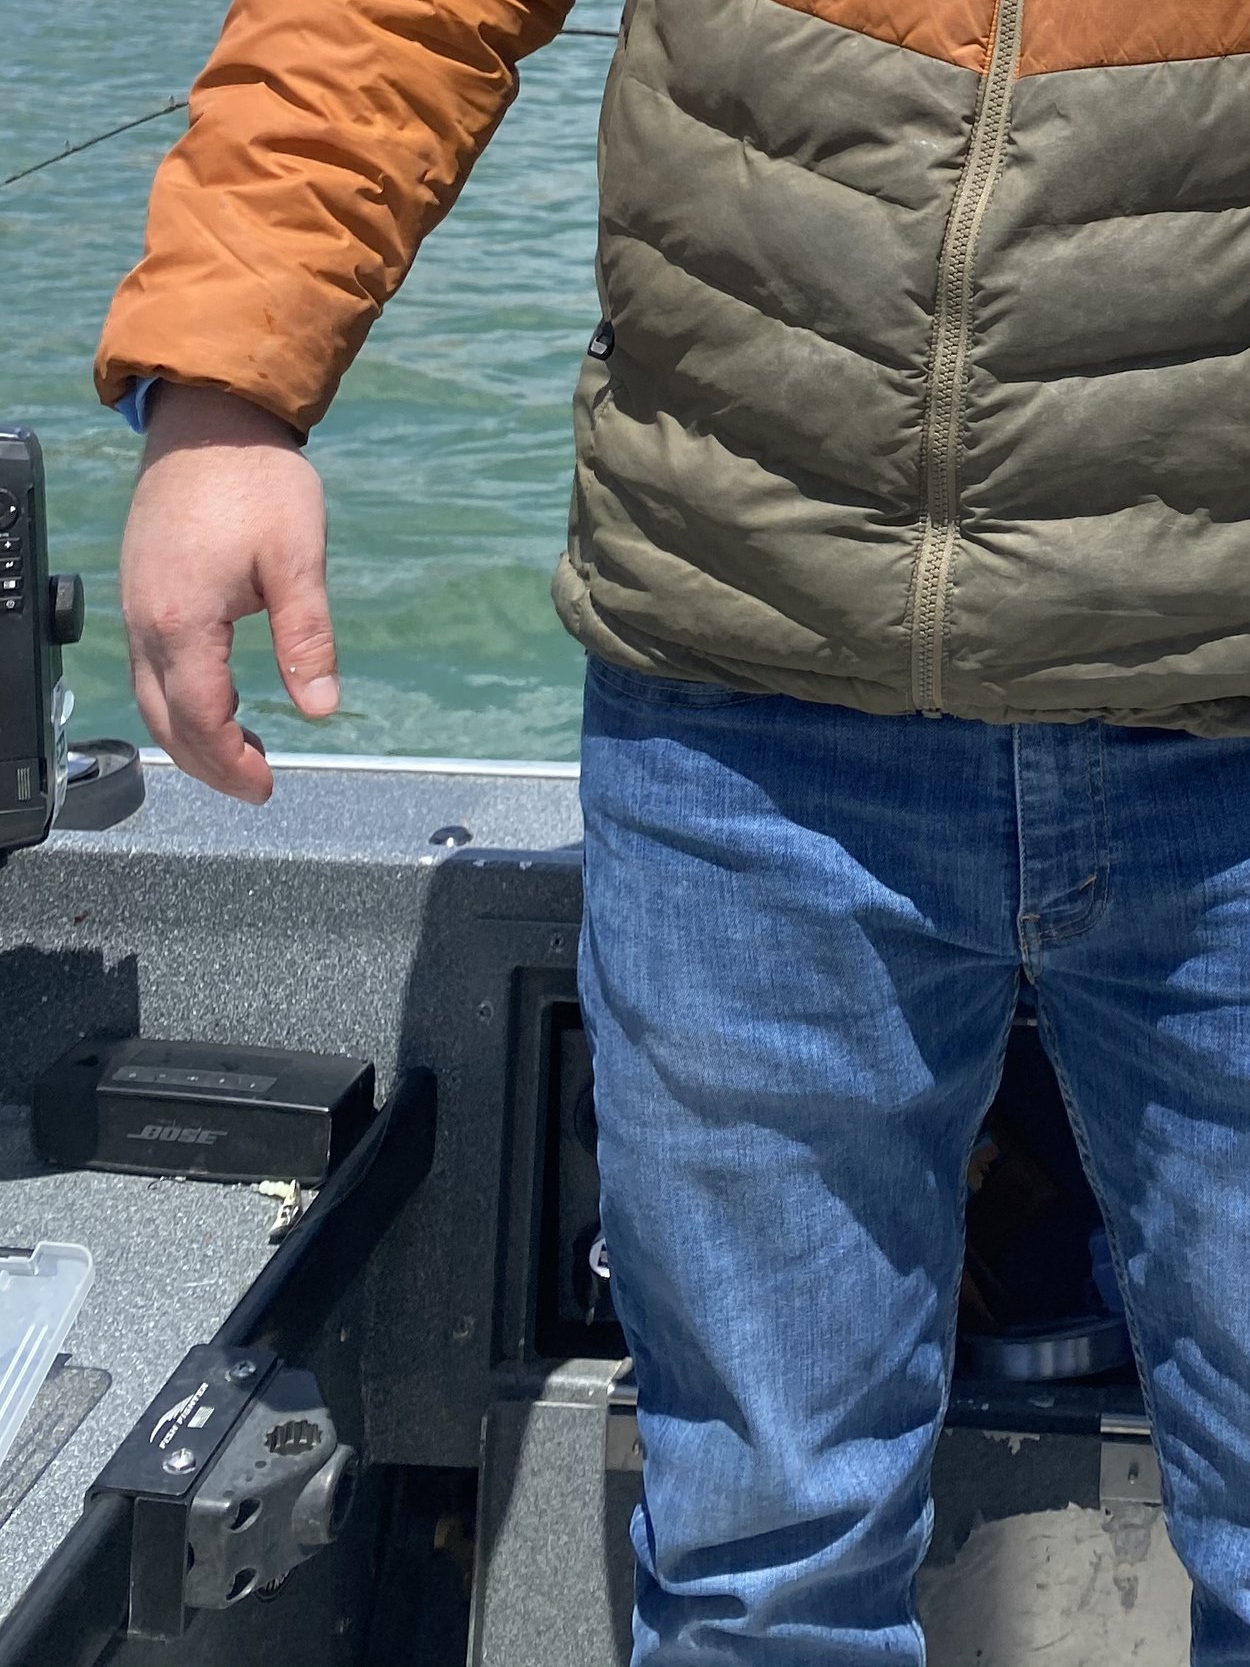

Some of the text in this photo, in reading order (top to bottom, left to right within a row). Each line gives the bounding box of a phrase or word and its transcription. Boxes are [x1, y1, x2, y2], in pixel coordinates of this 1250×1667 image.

[126, 1124, 228, 1145] BOSE
[158, 1382, 209, 1449] FISH FIGHTER
